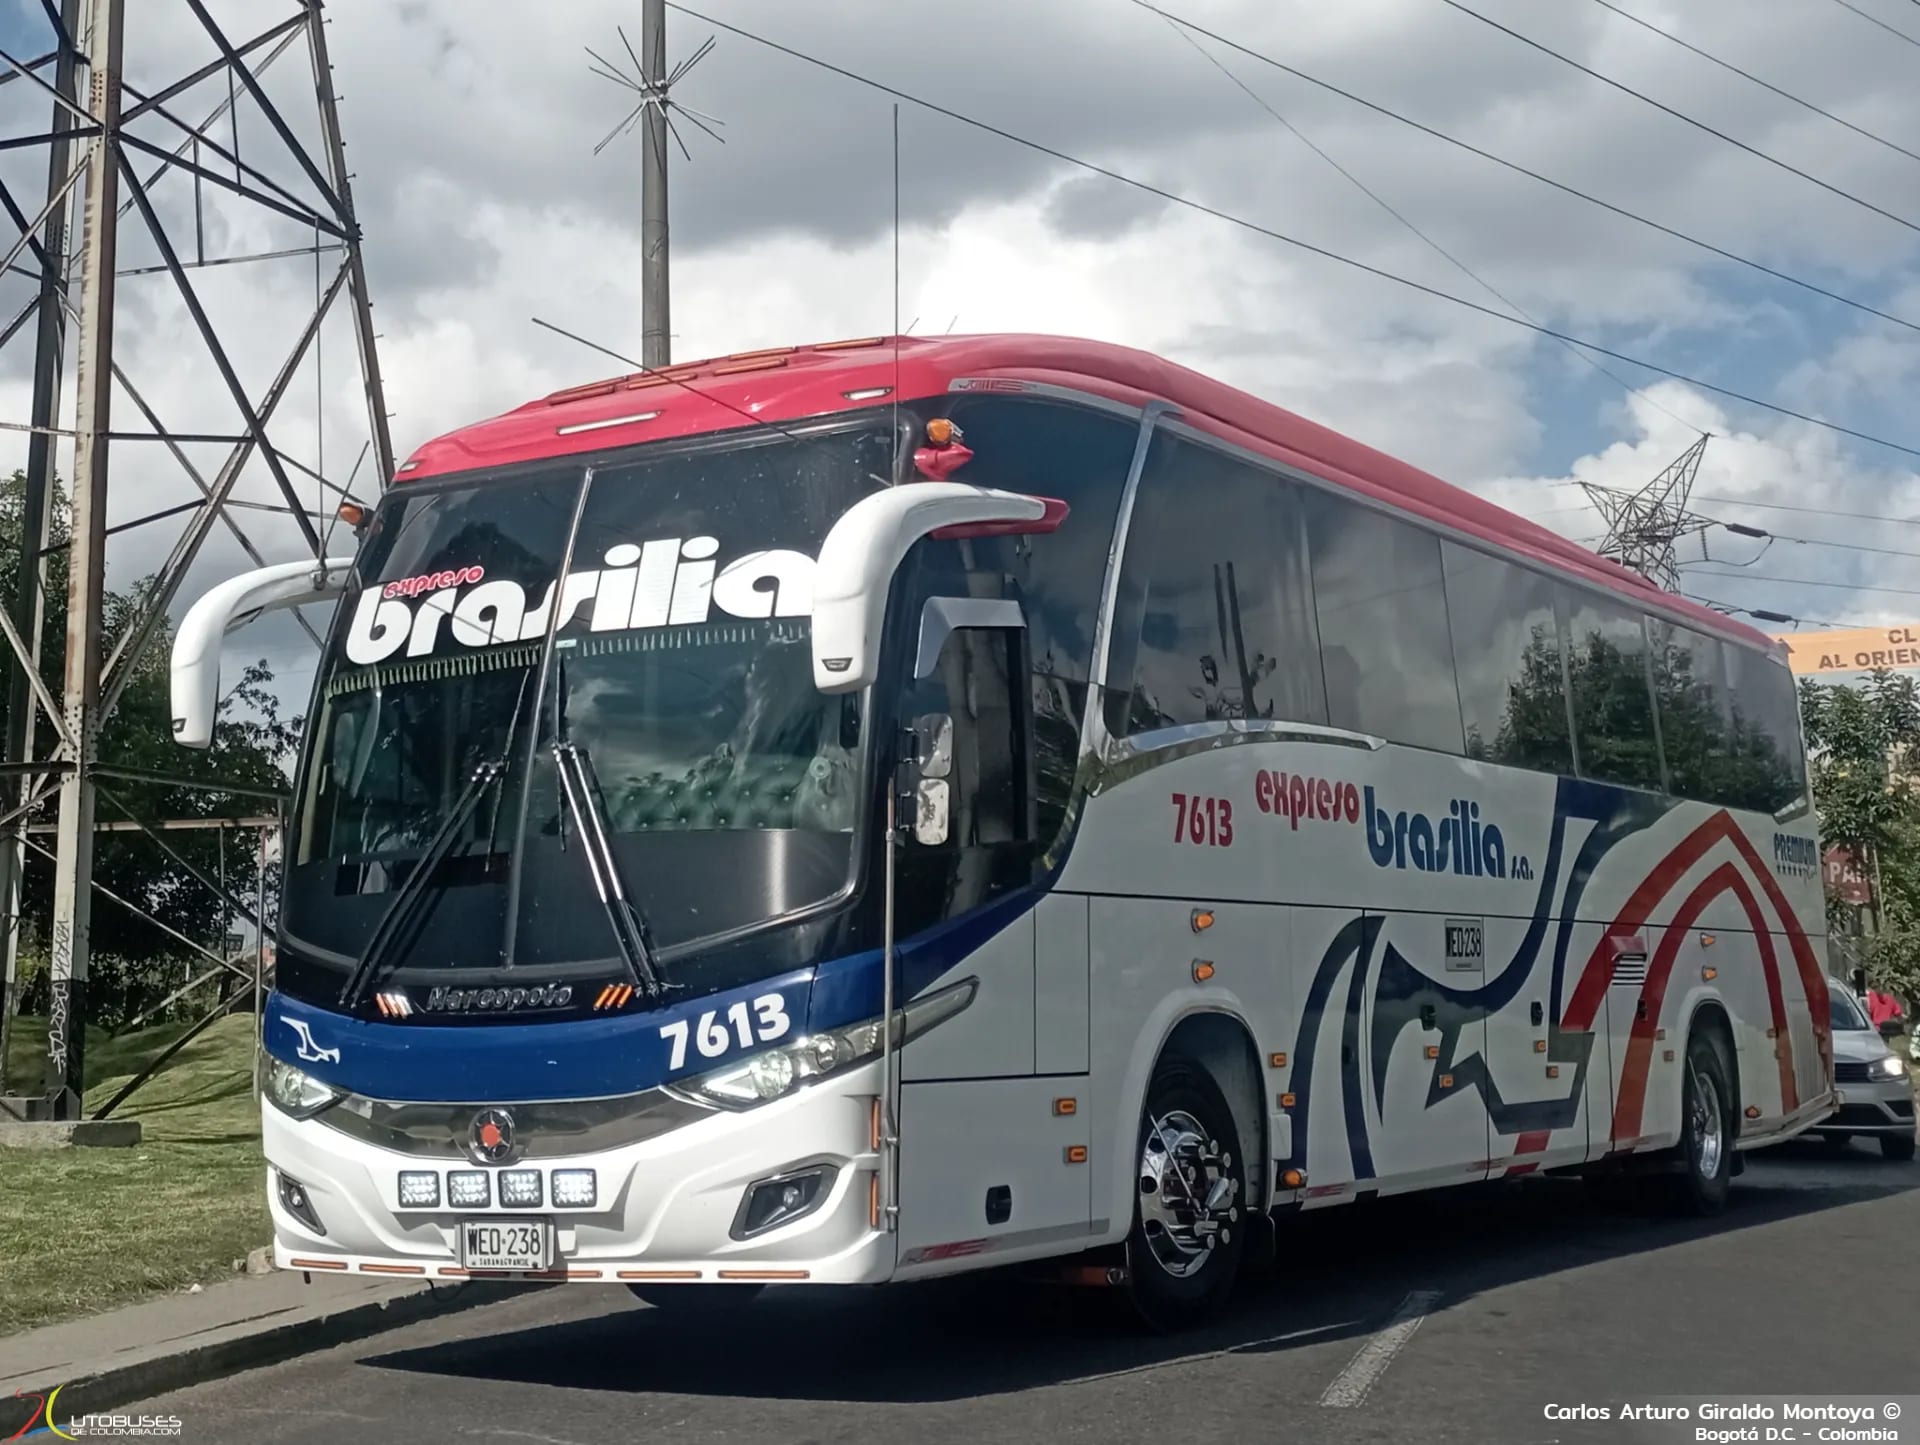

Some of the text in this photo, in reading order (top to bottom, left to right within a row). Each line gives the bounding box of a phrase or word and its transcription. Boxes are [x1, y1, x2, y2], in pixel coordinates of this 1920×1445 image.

[345, 535, 818, 665] brasilia
[383, 565, 484, 598] expreso
[1819, 654, 1847, 669] AL
[1172, 793, 1233, 847] 7613
[1255, 769, 1360, 831] expreso
[1363, 785, 1506, 878] brasilia
[426, 983, 573, 1011] Marcopolo
[659, 993, 790, 1071] 7613
